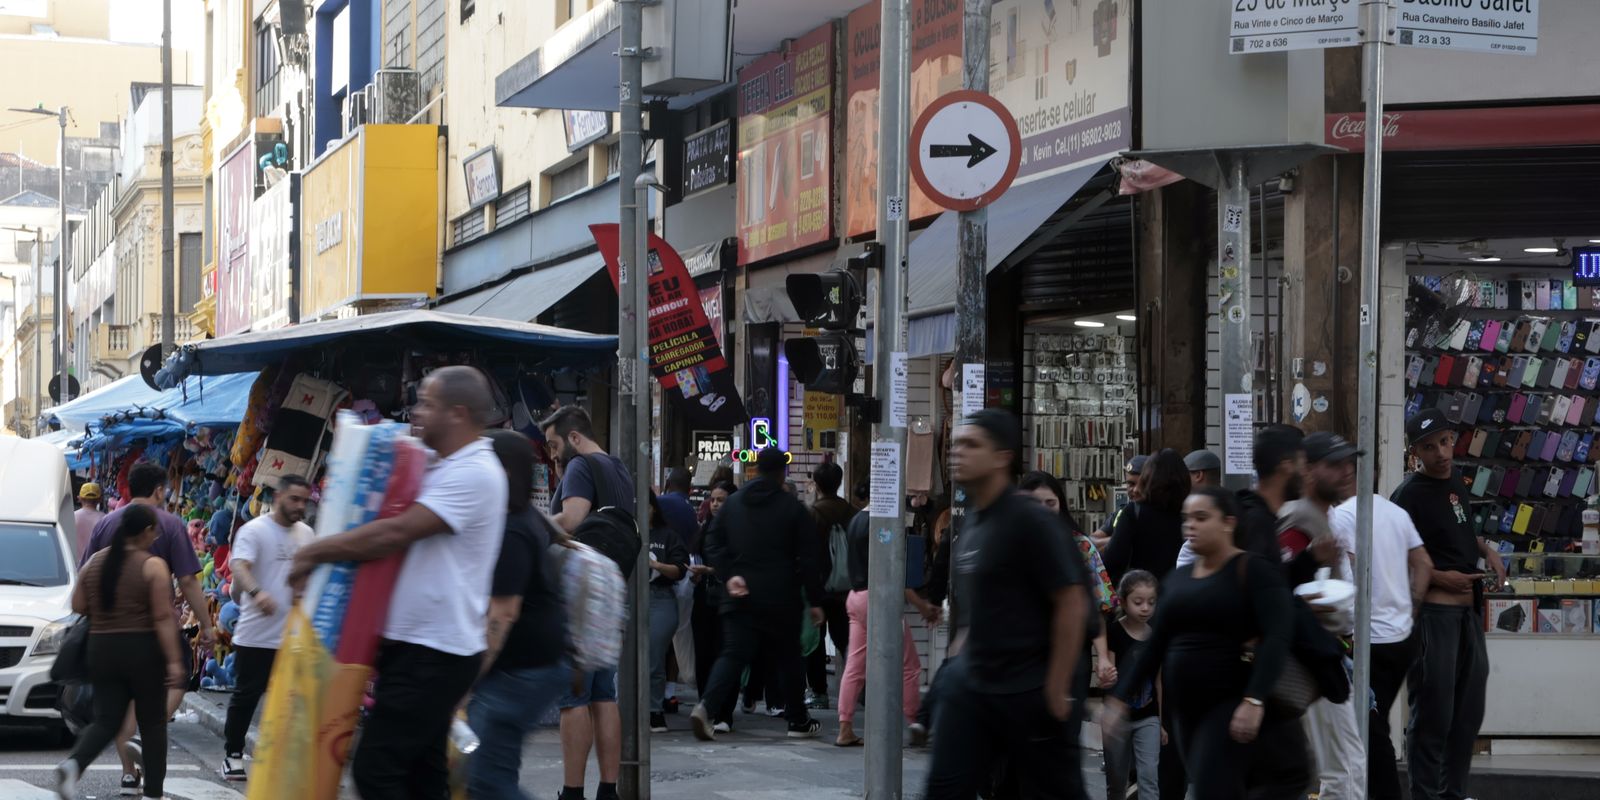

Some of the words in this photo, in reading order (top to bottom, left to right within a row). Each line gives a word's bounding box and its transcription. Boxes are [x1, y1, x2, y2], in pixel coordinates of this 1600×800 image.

[1234, 20, 1250, 30] Rua
[1251, 18, 1271, 28] Vinte
[1273, 19, 1278, 27] e
[1280, 15, 1304, 27] Cinco
[1305, 15, 1316, 25] de
[1318, 13, 1344, 25] Março
[1403, 12, 1420, 22] Rua
[1422, 13, 1470, 26] Cavalheiro
[1471, 18, 1501, 28] Basílio
[1503, 20, 1525, 30] Jafet
[1249, 39, 1264, 49] 702
[1272, 38, 1288, 48] 636
[1418, 34, 1430, 44] 23
[1431, 37, 1438, 45] a
[1439, 36, 1451, 46] 33
[1062, 88, 1098, 121] celular
[1033, 142, 1052, 162] Kevin
[648, 277, 680, 298] EU
[652, 331, 699, 354] PELÍCULA
[655, 340, 706, 364] CARREGADOR
[664, 353, 705, 374] CAPINHA
[816, 403, 835, 412] Vidro
[698, 440, 731, 453] PRATA
